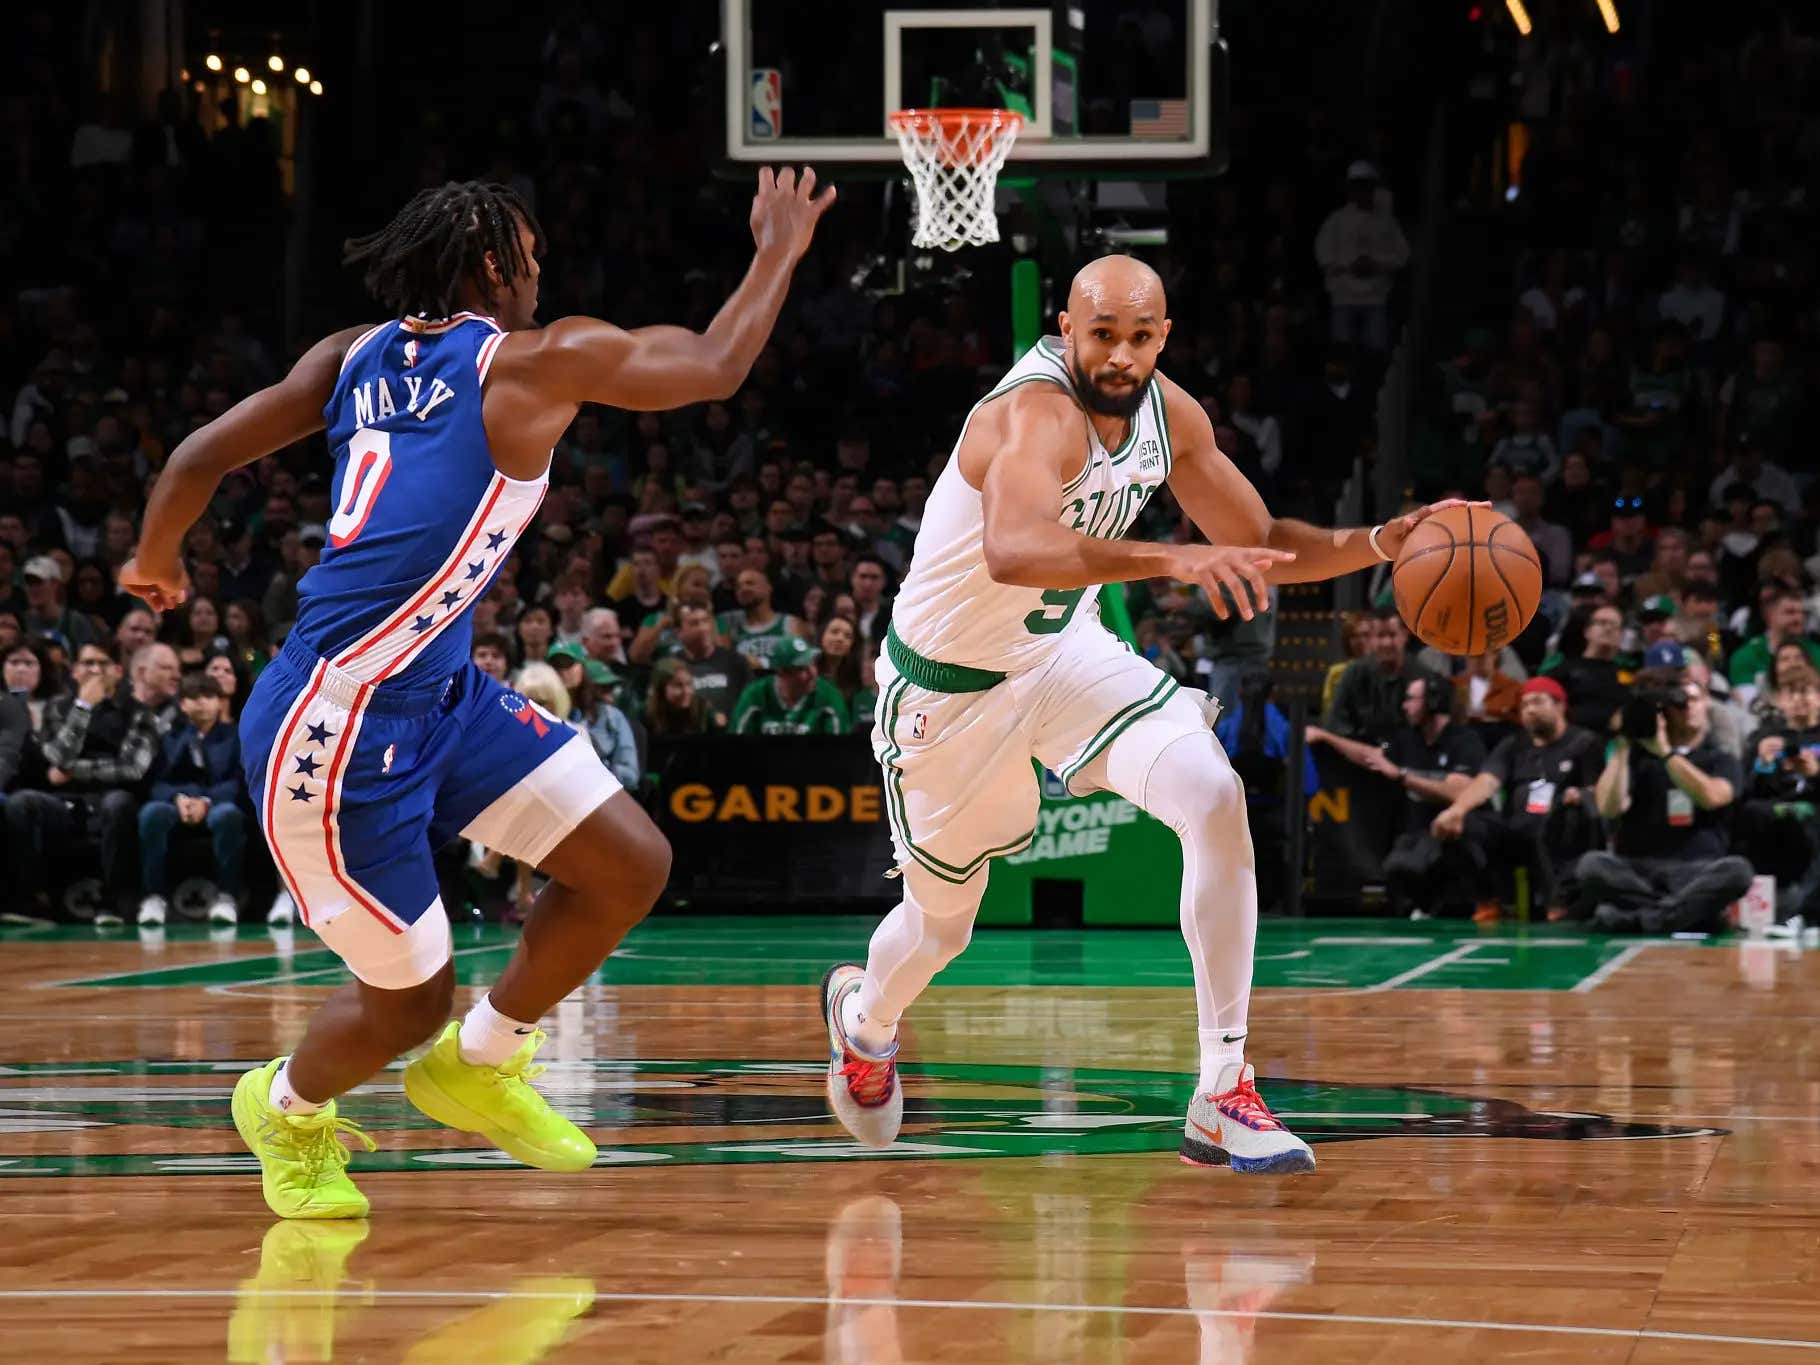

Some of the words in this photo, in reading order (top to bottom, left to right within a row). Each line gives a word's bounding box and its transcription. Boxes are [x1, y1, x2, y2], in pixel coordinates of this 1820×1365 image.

[329, 427, 393, 549] 0
[669, 783, 881, 823] GARDE
[1037, 798, 1139, 834] YONE
